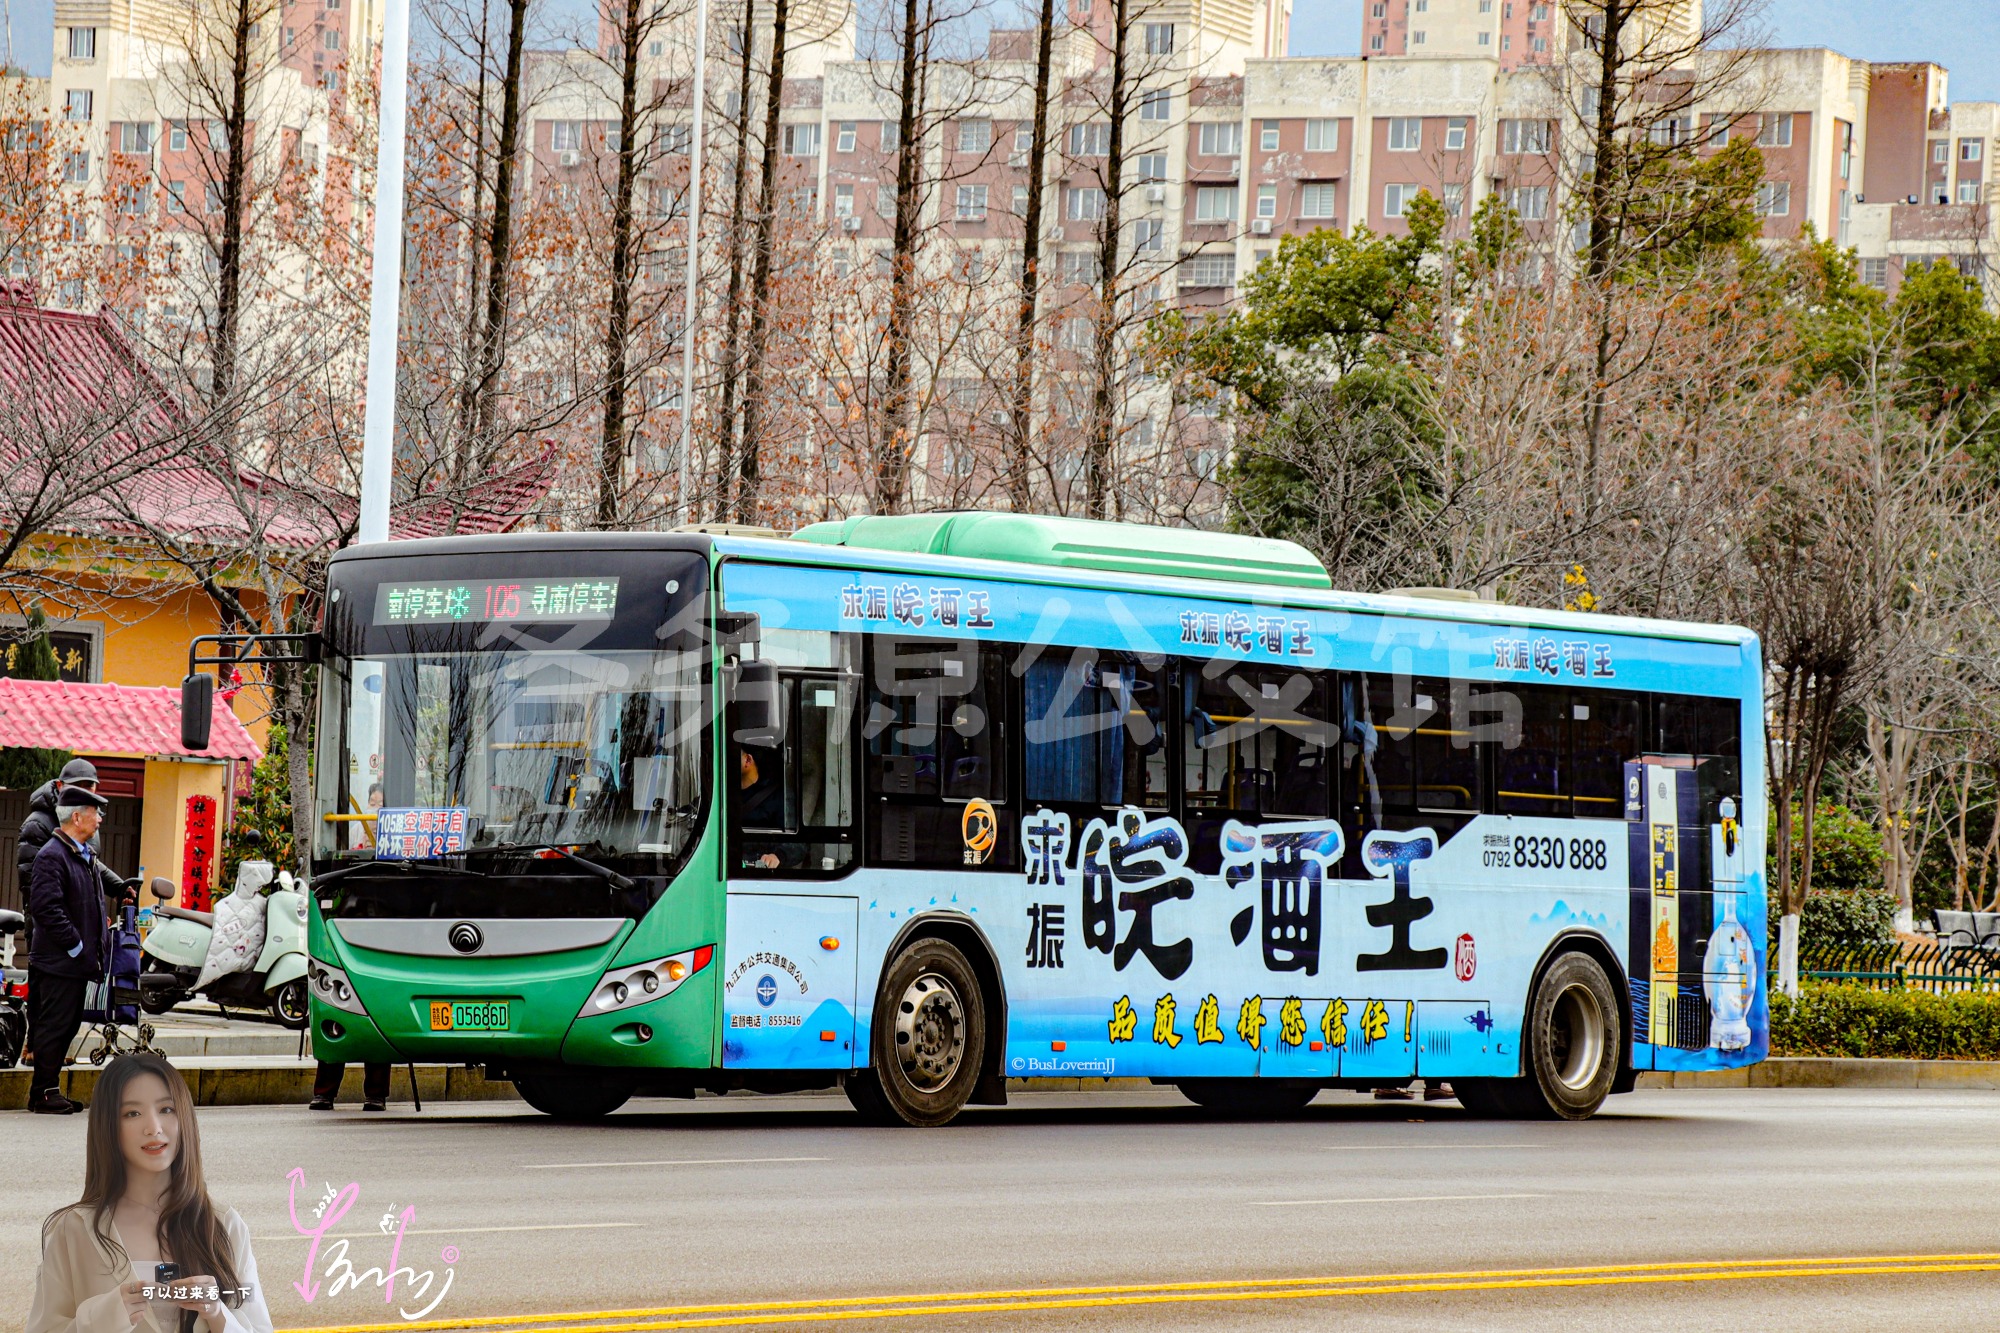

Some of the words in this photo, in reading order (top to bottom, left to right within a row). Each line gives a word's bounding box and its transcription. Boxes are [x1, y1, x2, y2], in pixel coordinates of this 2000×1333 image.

[484, 585, 521, 618] 105
[842, 582, 994, 629] 求振皖酒王
[1180, 610, 1315, 656] 求振皖酒王
[1493, 637, 1616, 679] 求振皖酒王
[380, 811, 463, 833] 105路空调开启
[378, 834, 461, 857] 外环票价2元
[1483, 850, 1511, 868] 0792
[1514, 835, 1565, 869] 8330
[1569, 838, 1607, 871] 888
[1022, 810, 1070, 969] 求振
[1080, 810, 1449, 982] 皖酒王
[725, 951, 809, 995] 九江市公共交通集团公司
